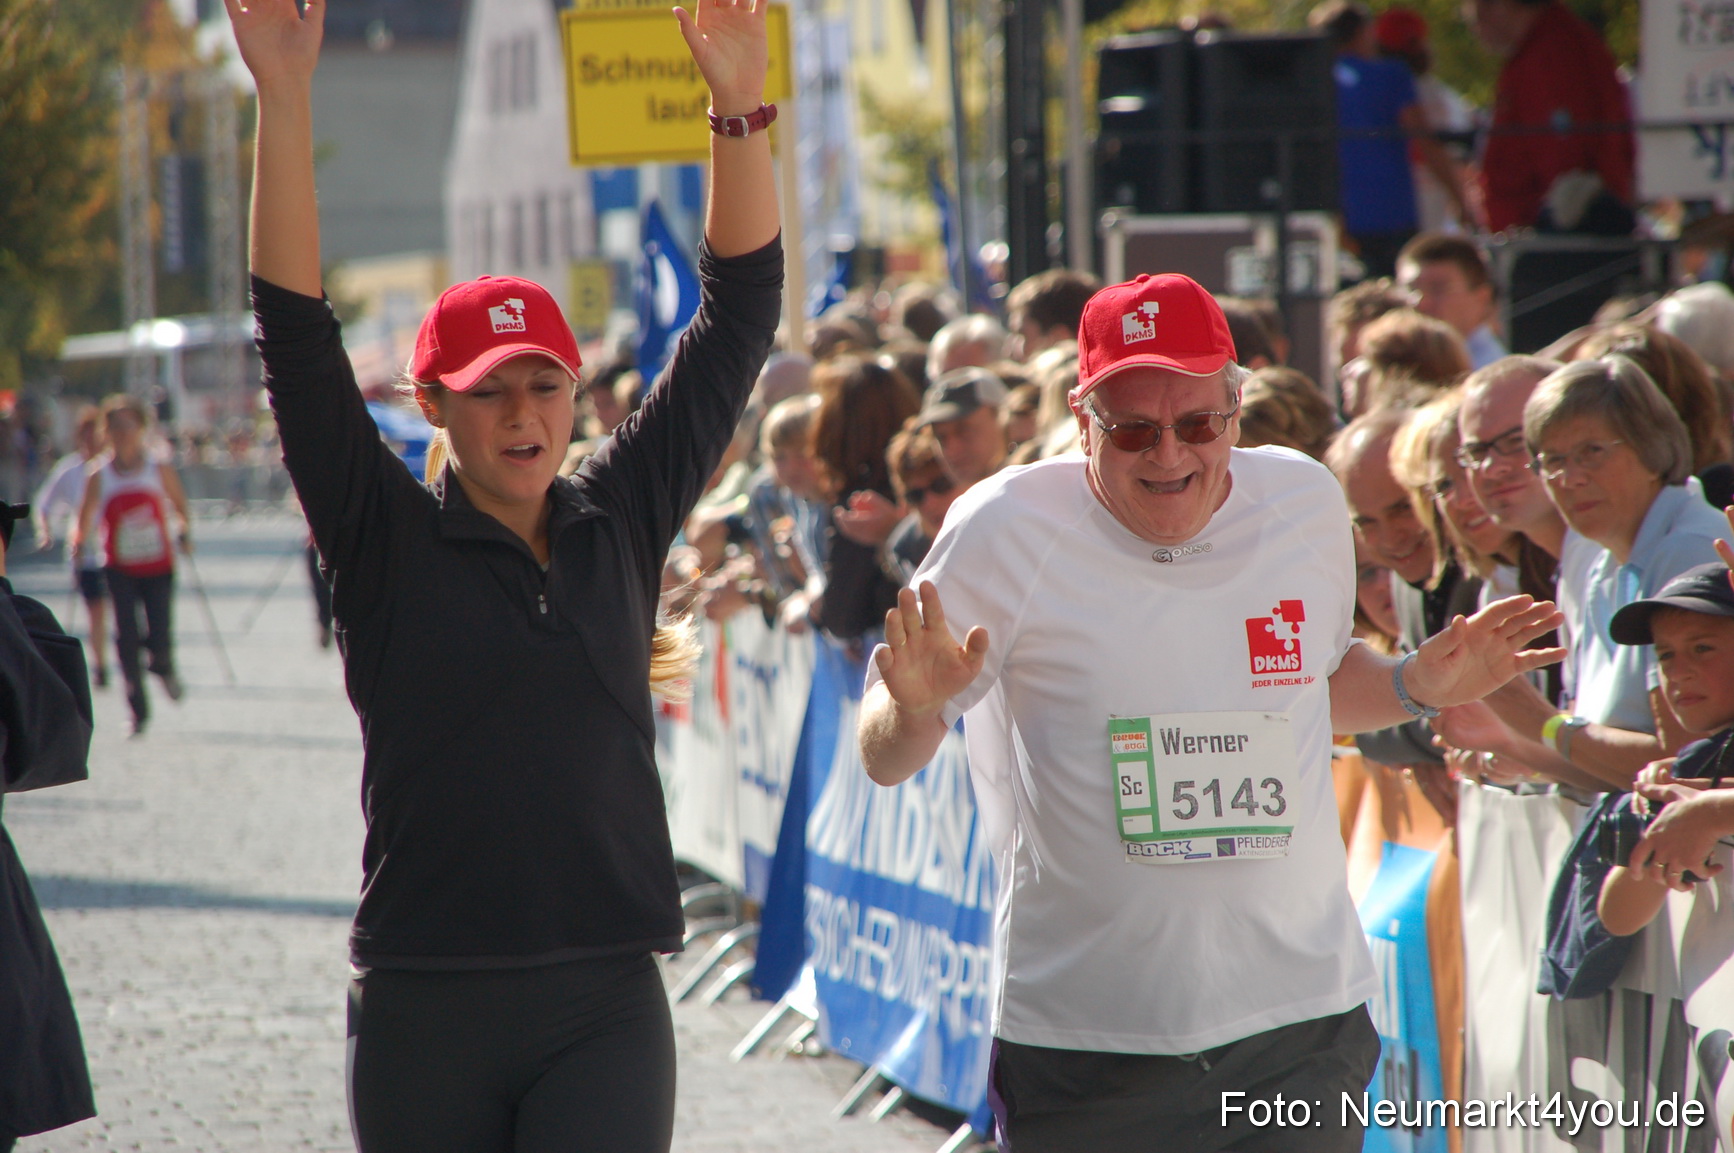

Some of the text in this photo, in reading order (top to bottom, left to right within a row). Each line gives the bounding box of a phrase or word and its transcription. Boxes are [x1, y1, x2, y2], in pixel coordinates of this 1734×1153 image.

[495, 321, 524, 331] DKMS
[1125, 328, 1154, 343] DKMS
[1253, 652, 1300, 672] DKMS
[1251, 679, 1272, 689] JEDER
[1273, 677, 1303, 686] EINZELNE
[1159, 727, 1249, 755] Werner
[1120, 775, 1143, 796] Sc
[1172, 777, 1287, 820] 5143
[1126, 840, 1193, 857] BOCK
[1237, 836, 1290, 849] PFLEIDERER
